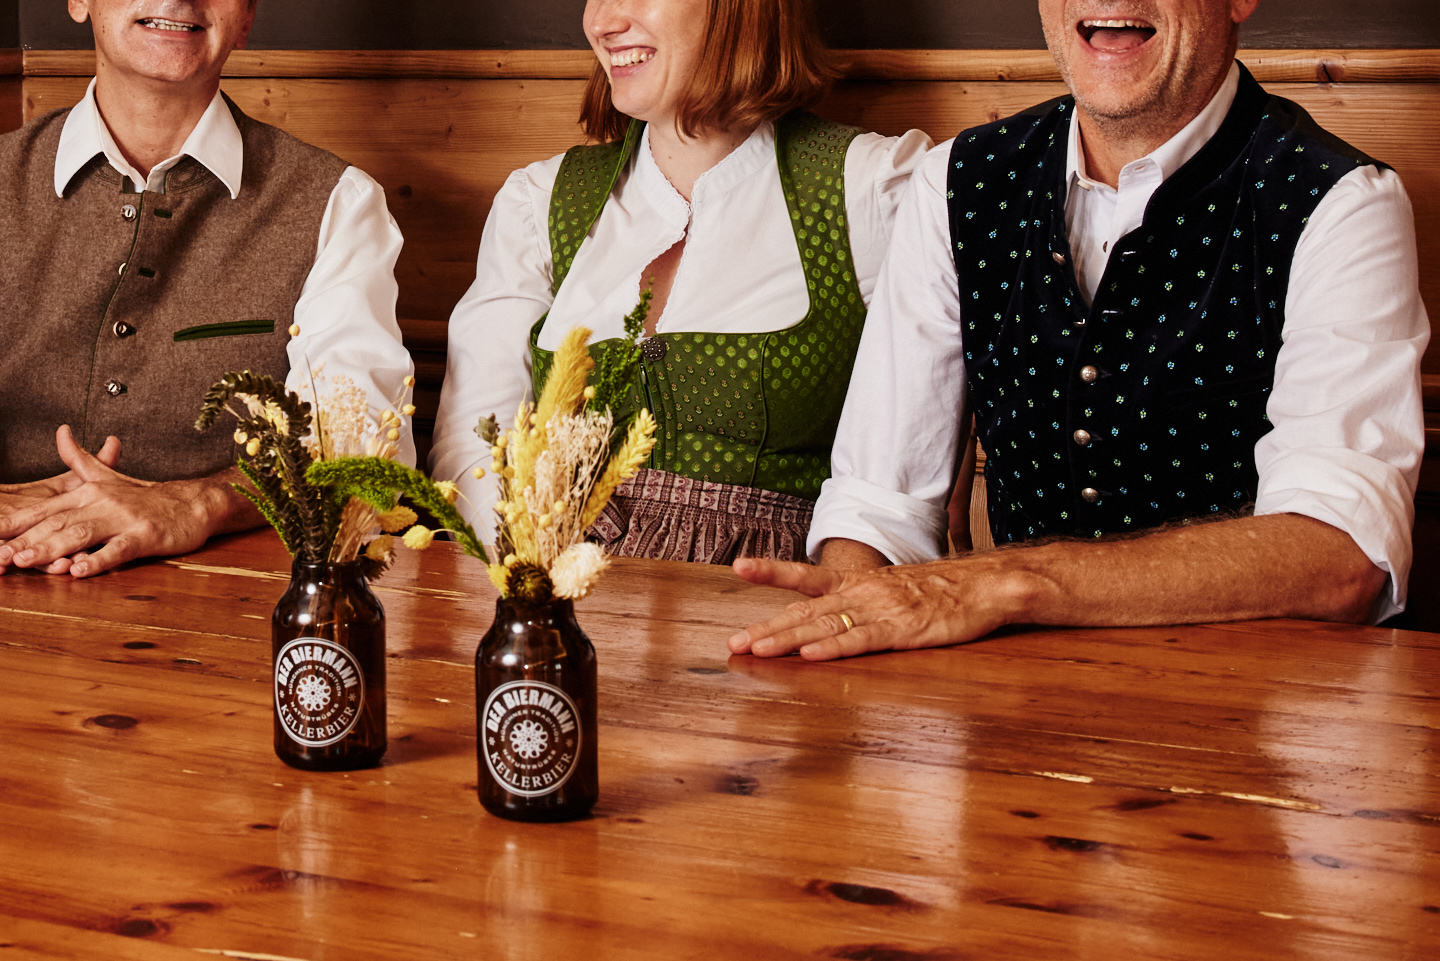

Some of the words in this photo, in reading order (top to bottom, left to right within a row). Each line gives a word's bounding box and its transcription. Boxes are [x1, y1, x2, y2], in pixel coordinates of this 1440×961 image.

[278, 656, 294, 687] DER
[290, 645, 358, 688] BIERMANN
[315, 665, 342, 696] TRADITION
[280, 703, 355, 738] KELLERBIER
[486, 700, 506, 733] DER
[502, 688, 575, 734] BIERMANN
[530, 709, 559, 742] TRADITION
[490, 752, 573, 788] KELLERBIER
